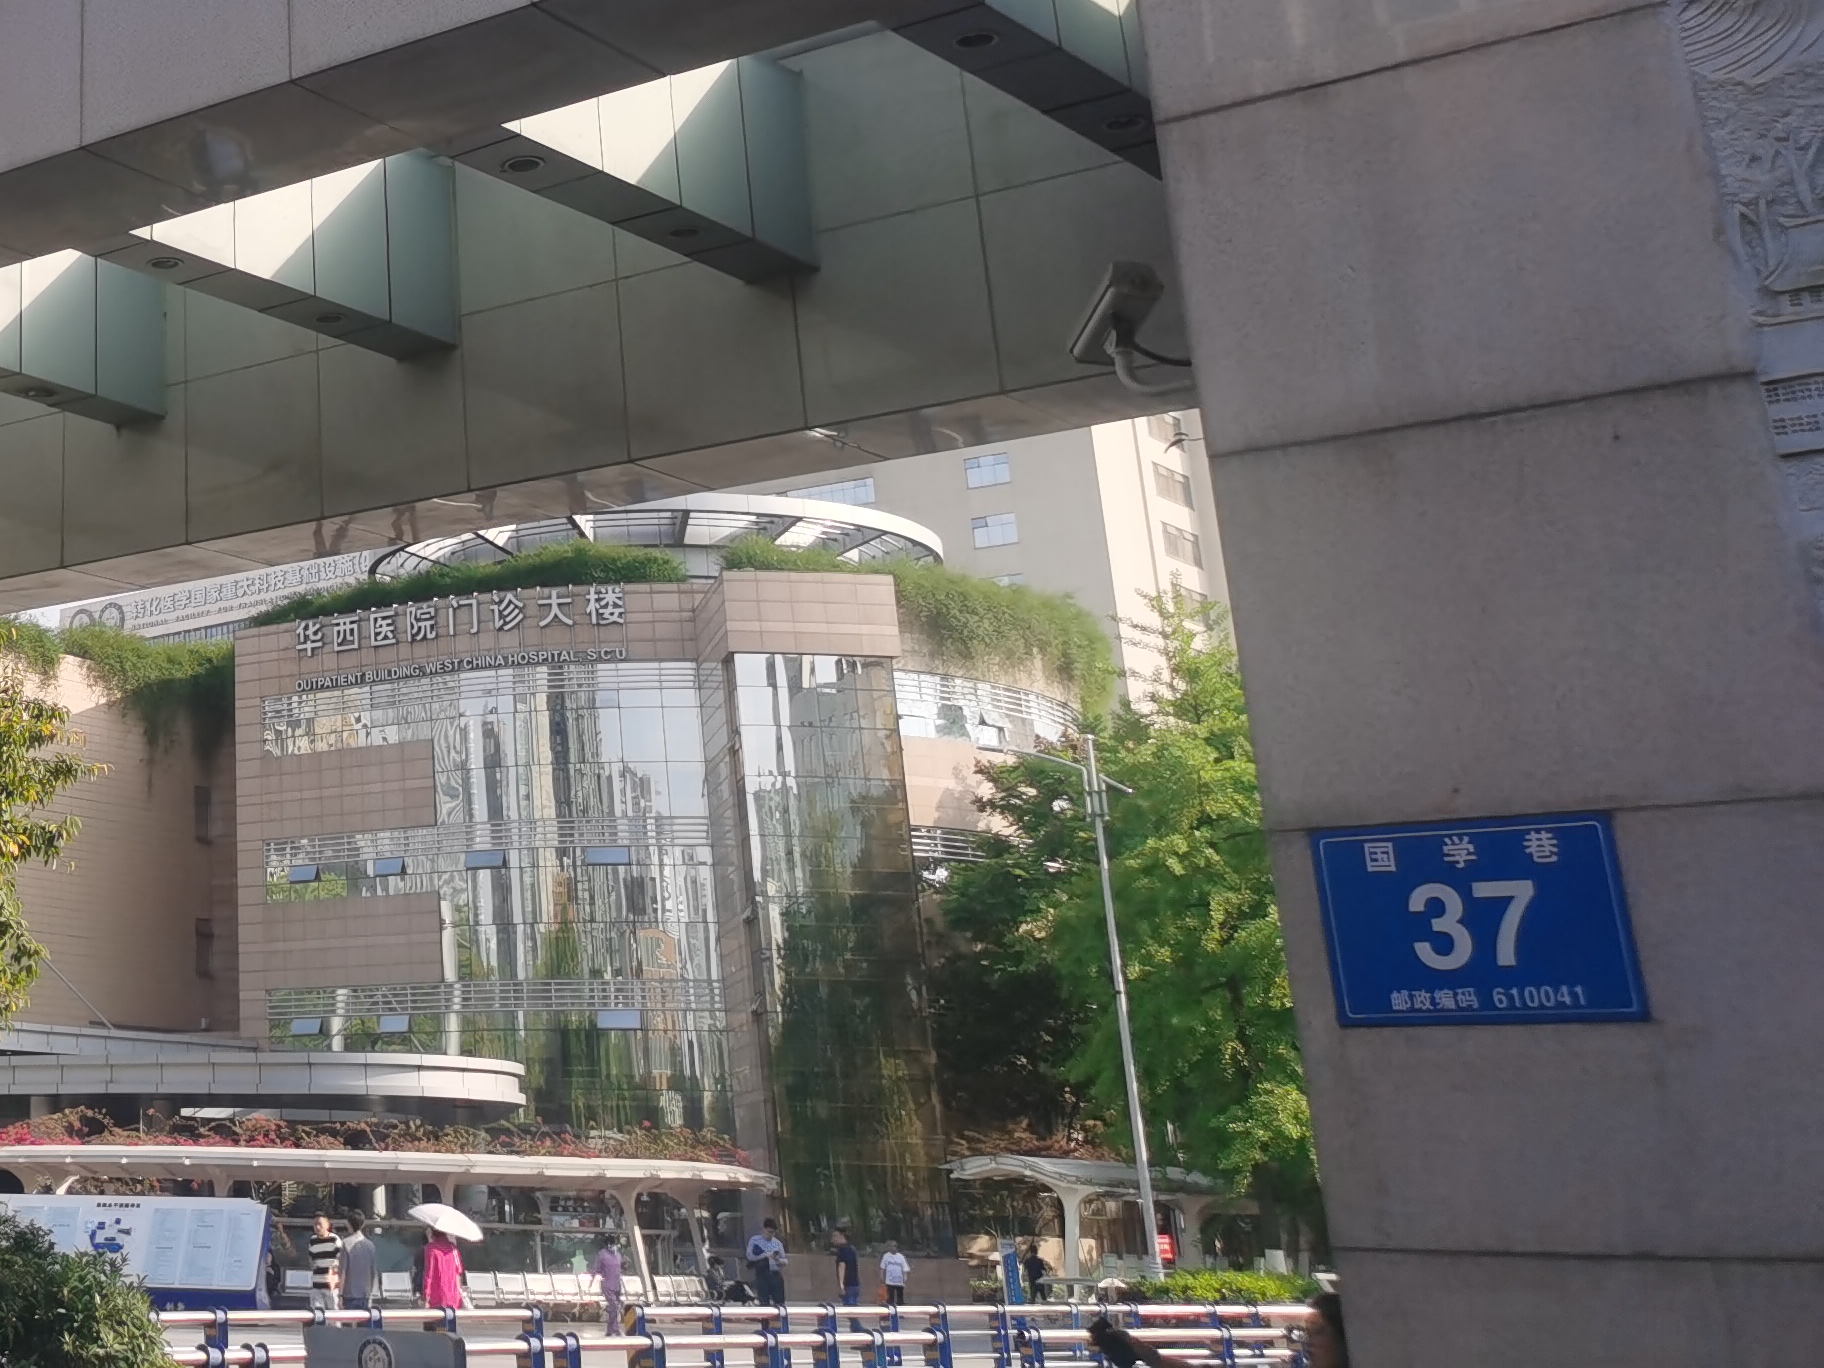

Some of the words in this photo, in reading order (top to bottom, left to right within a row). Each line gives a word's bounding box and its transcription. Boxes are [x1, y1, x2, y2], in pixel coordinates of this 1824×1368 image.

[295, 586, 626, 658] 华西医院门诊大楼
[295, 671, 363, 692] OUTPATIENT
[365, 663, 424, 683] BUILDING,
[425, 657, 460, 675] WEST
[463, 654, 505, 669] CHINA
[508, 649, 583, 666] HOSPITAL,
[1363, 830, 1560, 874] 国学巷
[1407, 879, 1536, 971] 37
[1390, 986, 1479, 1012] 邮政编码
[1492, 984, 1588, 1010] 610041
